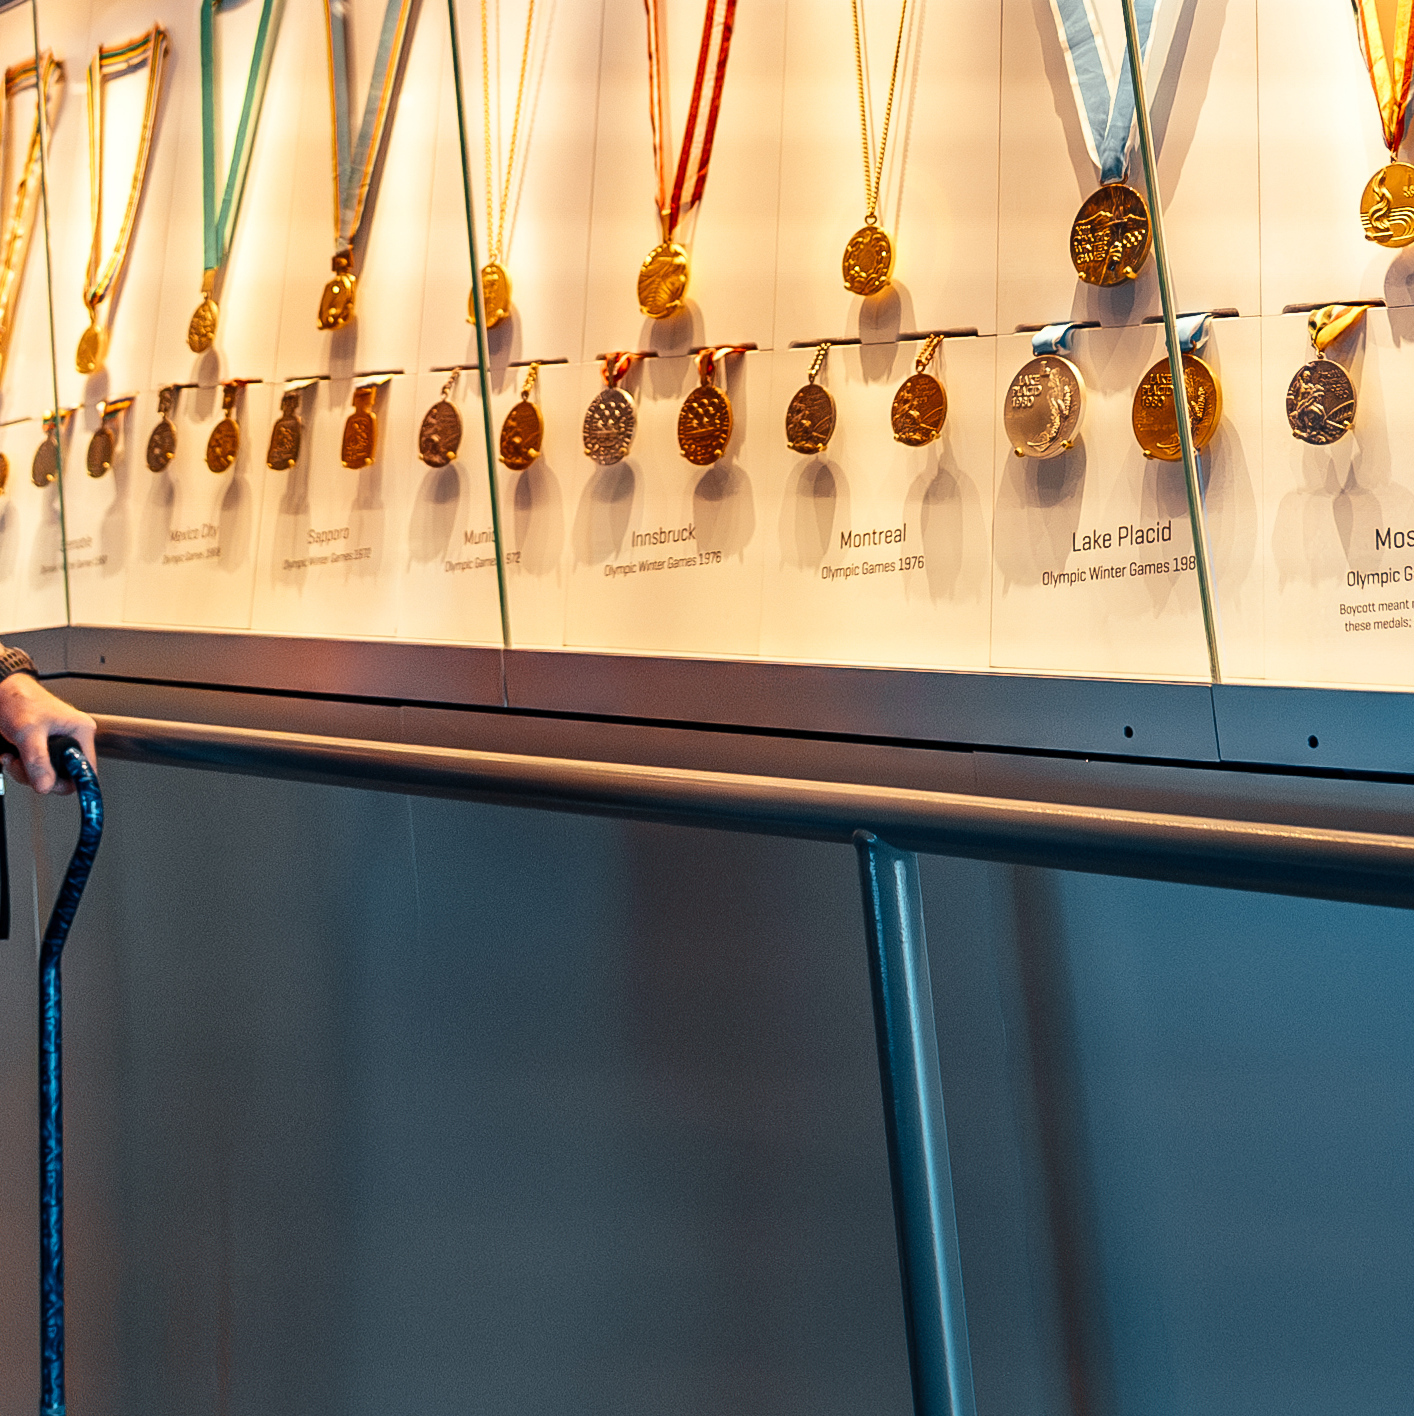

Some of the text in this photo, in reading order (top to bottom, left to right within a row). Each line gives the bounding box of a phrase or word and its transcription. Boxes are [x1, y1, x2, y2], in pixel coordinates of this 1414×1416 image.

[307, 527, 350, 547] Sapporo
[464, 527, 495, 546] Munic
[631, 523, 696, 548] Innsbruck
[840, 522, 907, 550] Montreal
[1072, 520, 1172, 553] Lake Placid
[475, 555, 498, 568] Game
[506, 551, 521, 565] 972
[604, 550, 722, 578] Olympic Winter Games 1976
[821, 555, 925, 581] Olympic Games 1976
[1042, 555, 1197, 589] Olympic Winter Games 198
[1347, 567, 1401, 590] Olympic
[1339, 601, 1376, 617] Boycott
[1378, 599, 1410, 612] meant
[1344, 620, 1372, 632] these
